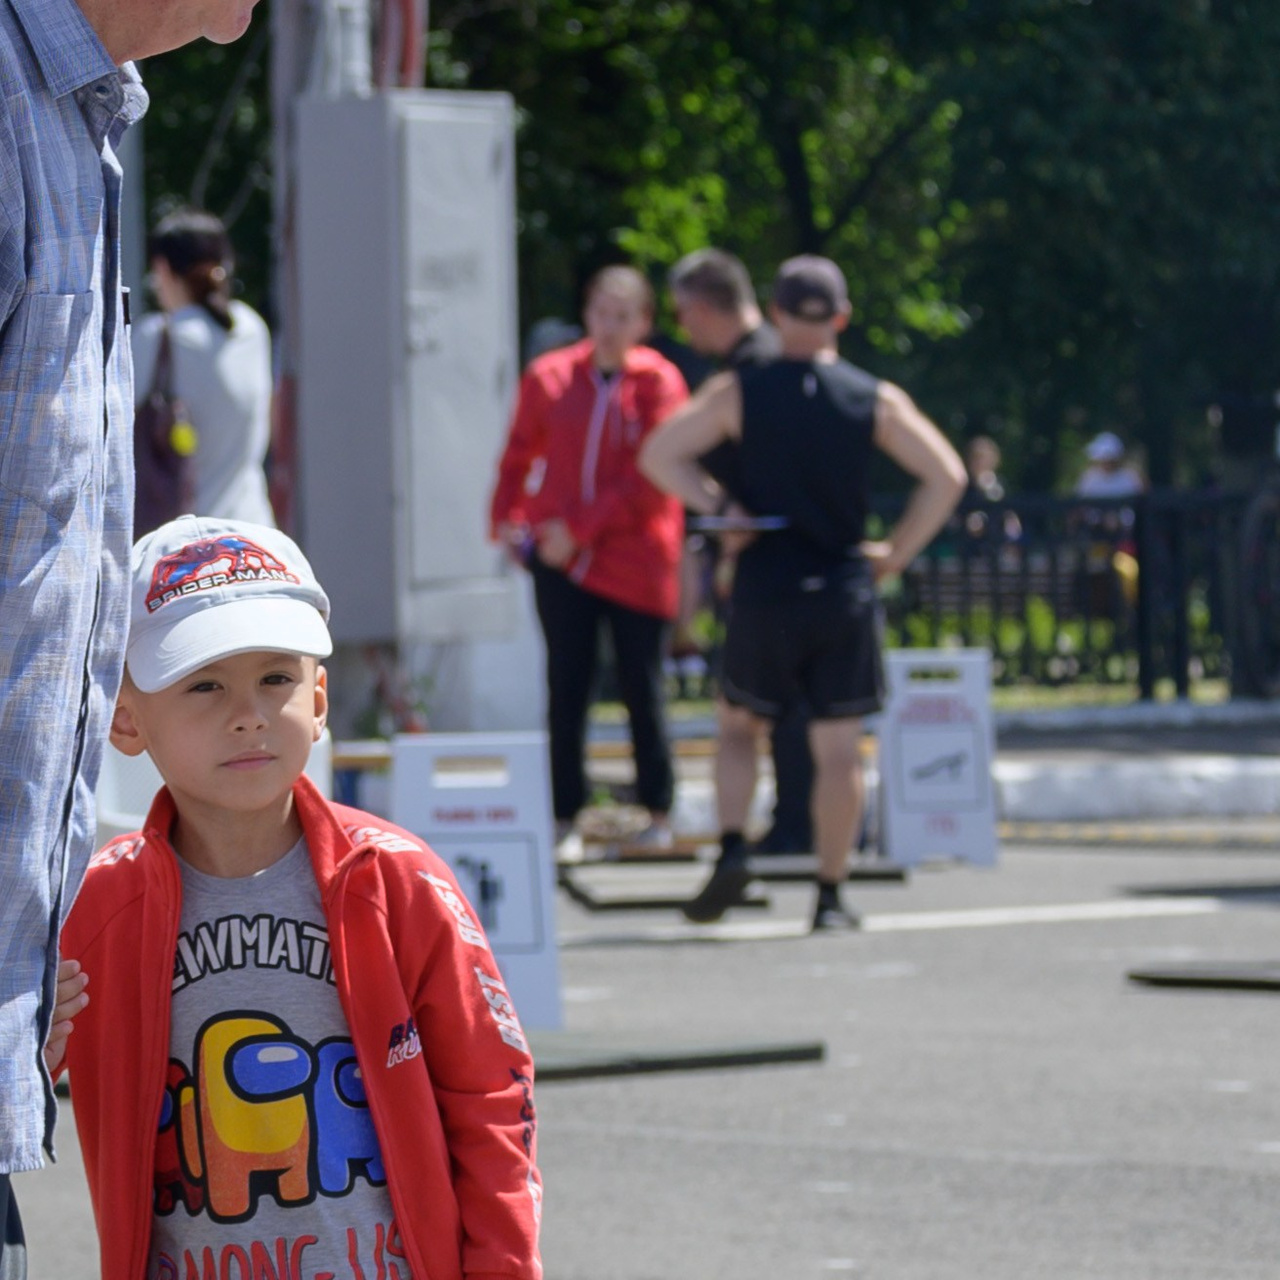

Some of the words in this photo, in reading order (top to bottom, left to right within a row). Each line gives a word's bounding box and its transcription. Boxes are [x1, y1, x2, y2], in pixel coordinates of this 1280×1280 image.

[149, 569, 287, 610] SPIDER-MAN
[418, 870, 488, 951] BEST
[172, 914, 337, 996] WMAT
[474, 967, 528, 1054] BEST
